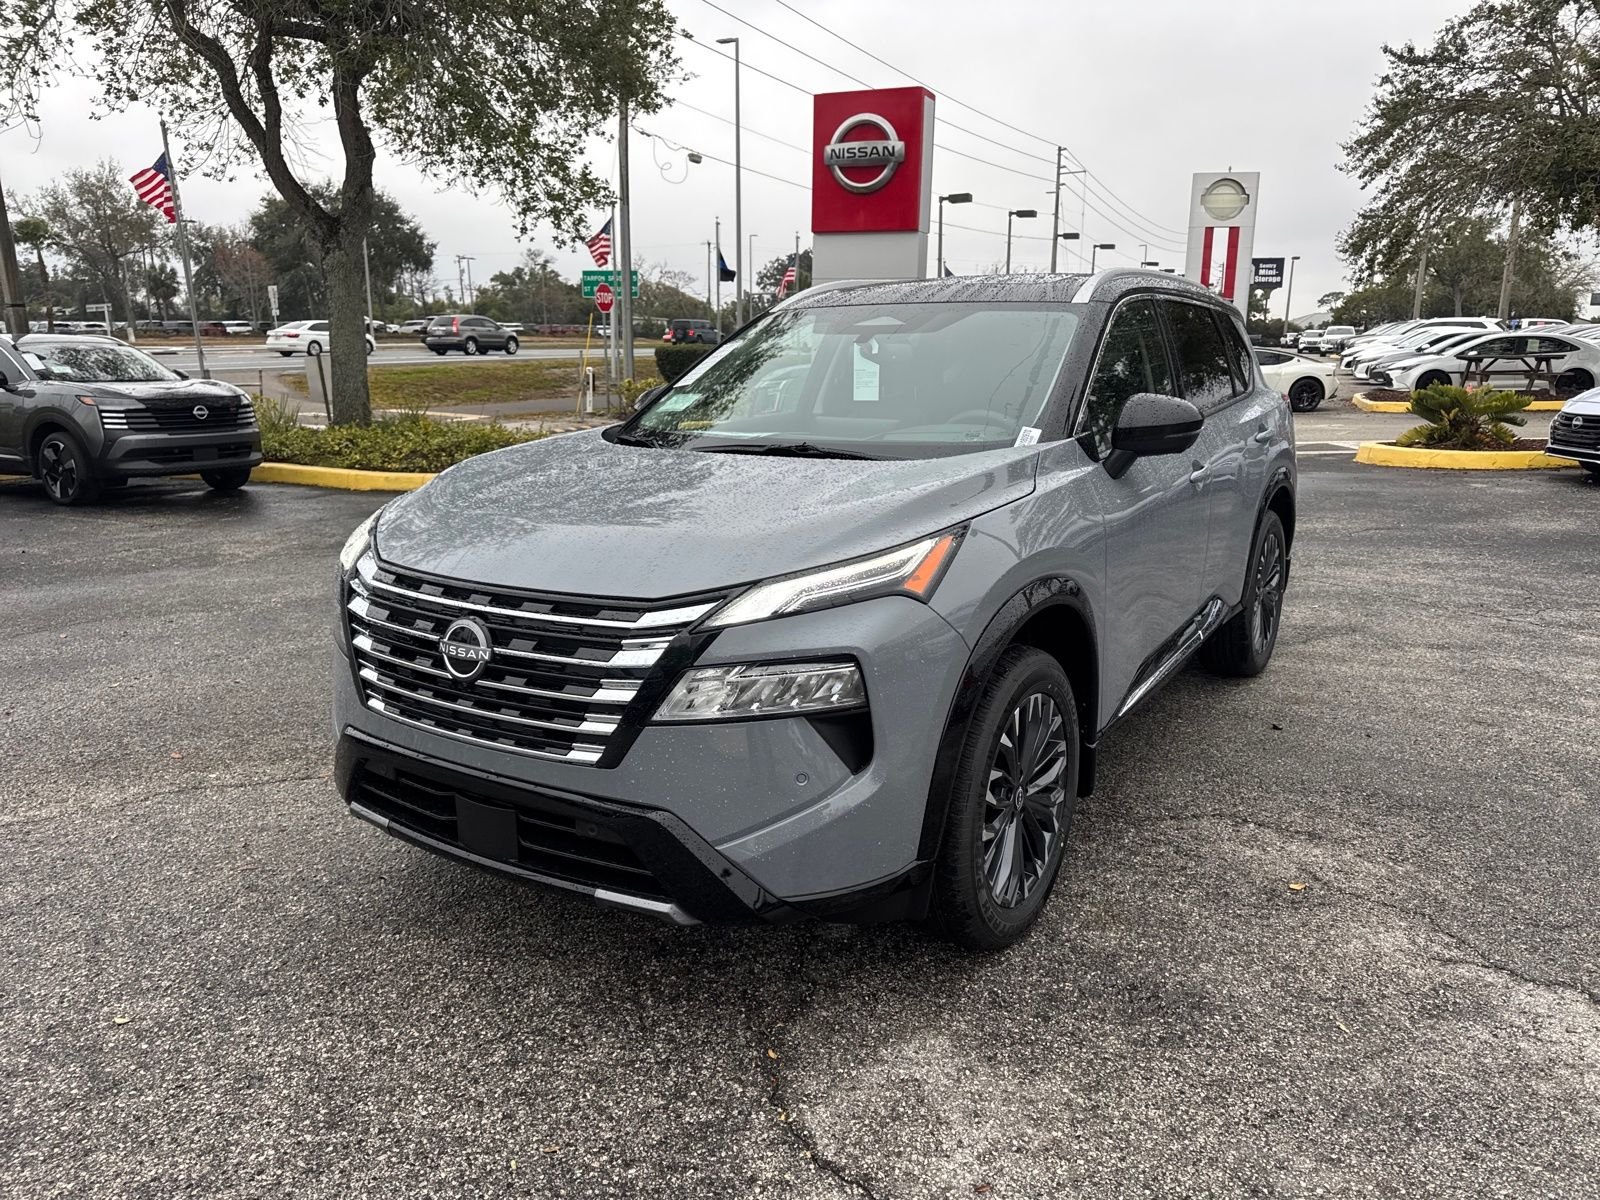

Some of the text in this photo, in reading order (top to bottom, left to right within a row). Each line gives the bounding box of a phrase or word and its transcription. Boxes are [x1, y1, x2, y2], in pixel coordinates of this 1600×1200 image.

[830, 145, 896, 160] NISSAN
[596, 292, 613, 304] STOP
[439, 642, 489, 660] NISSAN
